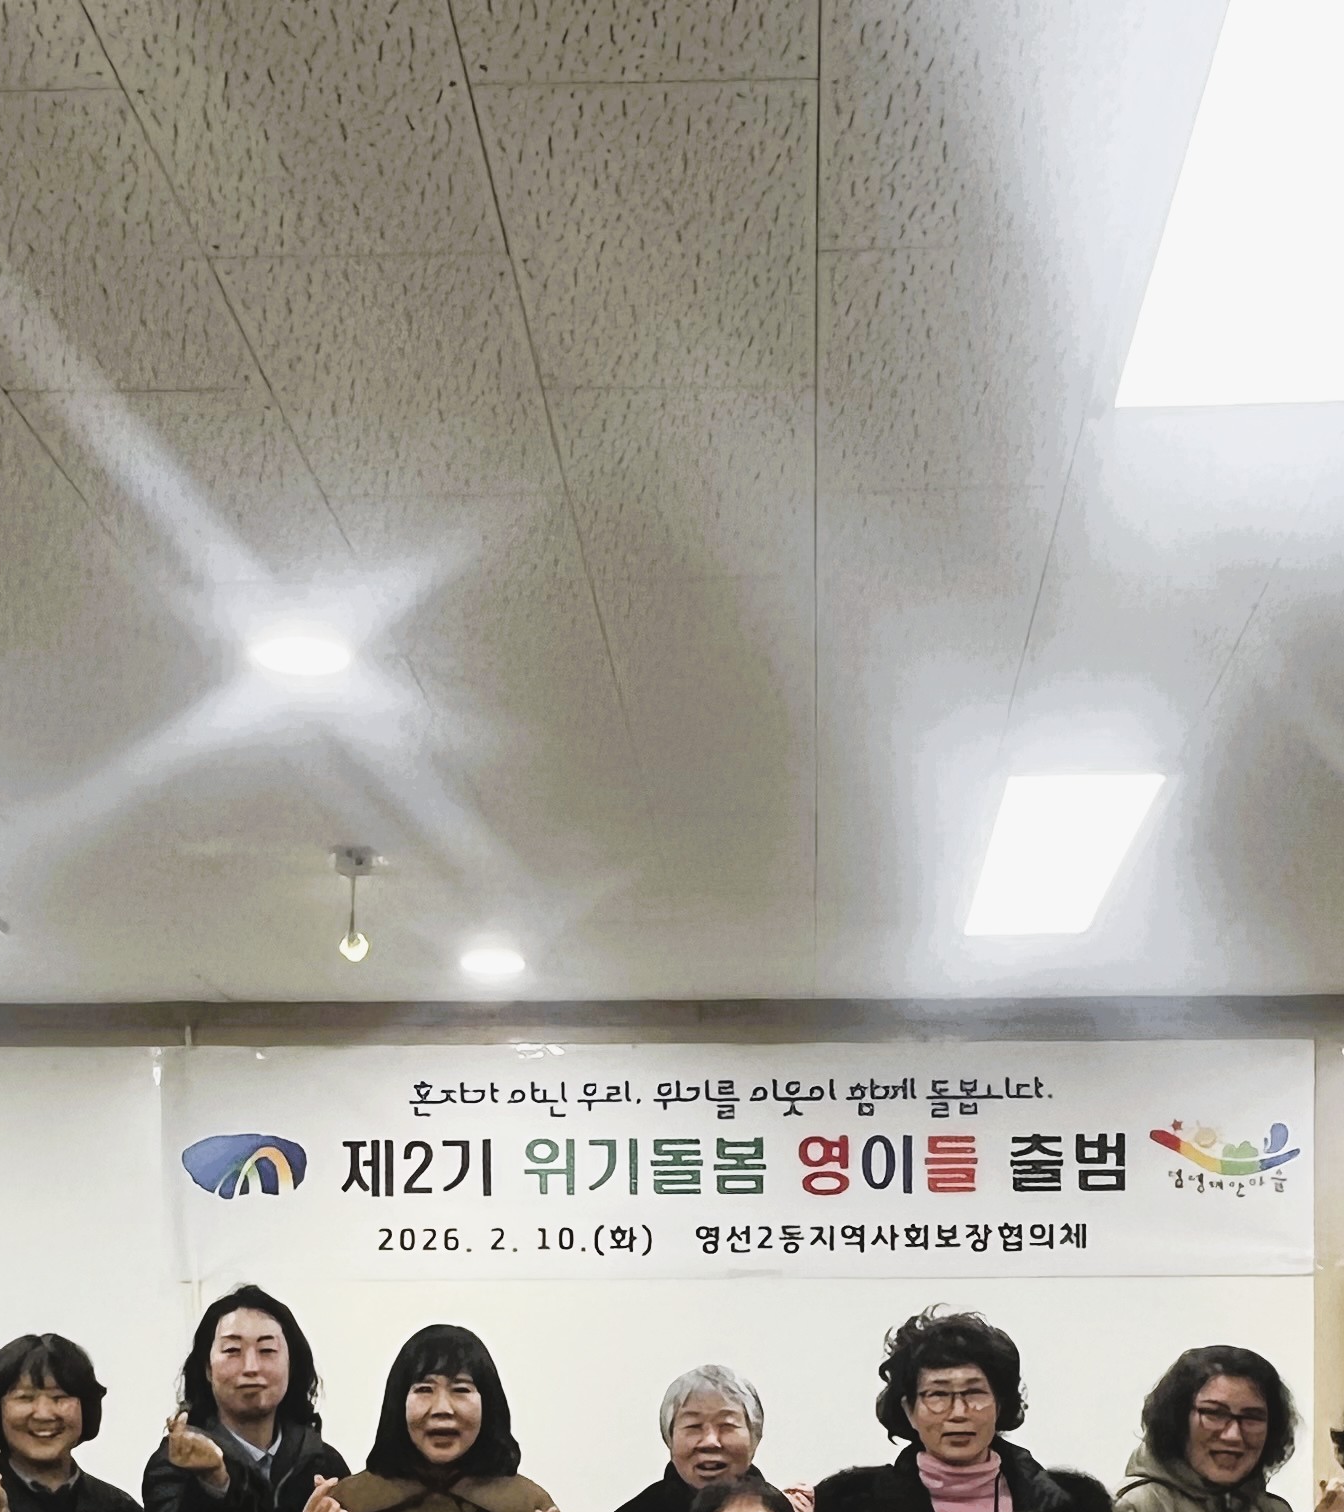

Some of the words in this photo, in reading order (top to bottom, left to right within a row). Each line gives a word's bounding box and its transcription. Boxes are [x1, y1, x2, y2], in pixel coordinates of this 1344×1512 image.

[408, 1080, 500, 1117] 혼자가
[506, 1080, 568, 1117] 아닌
[653, 1079, 740, 1119] 위기를
[749, 1078, 837, 1117] 이웃이
[845, 1077, 918, 1117] 함께
[925, 1076, 1054, 1119] 돌봅니다.
[340, 1137, 493, 1198] 제2기
[523, 1137, 767, 1196] 위기돌봄
[797, 1134, 979, 1196] 영이들
[1009, 1132, 1126, 1192] 출범
[377, 1226, 472, 1253] 2026.
[489, 1226, 519, 1253] 2.
[694, 1222, 1089, 1255] 영선2동지역사회보장협의체
